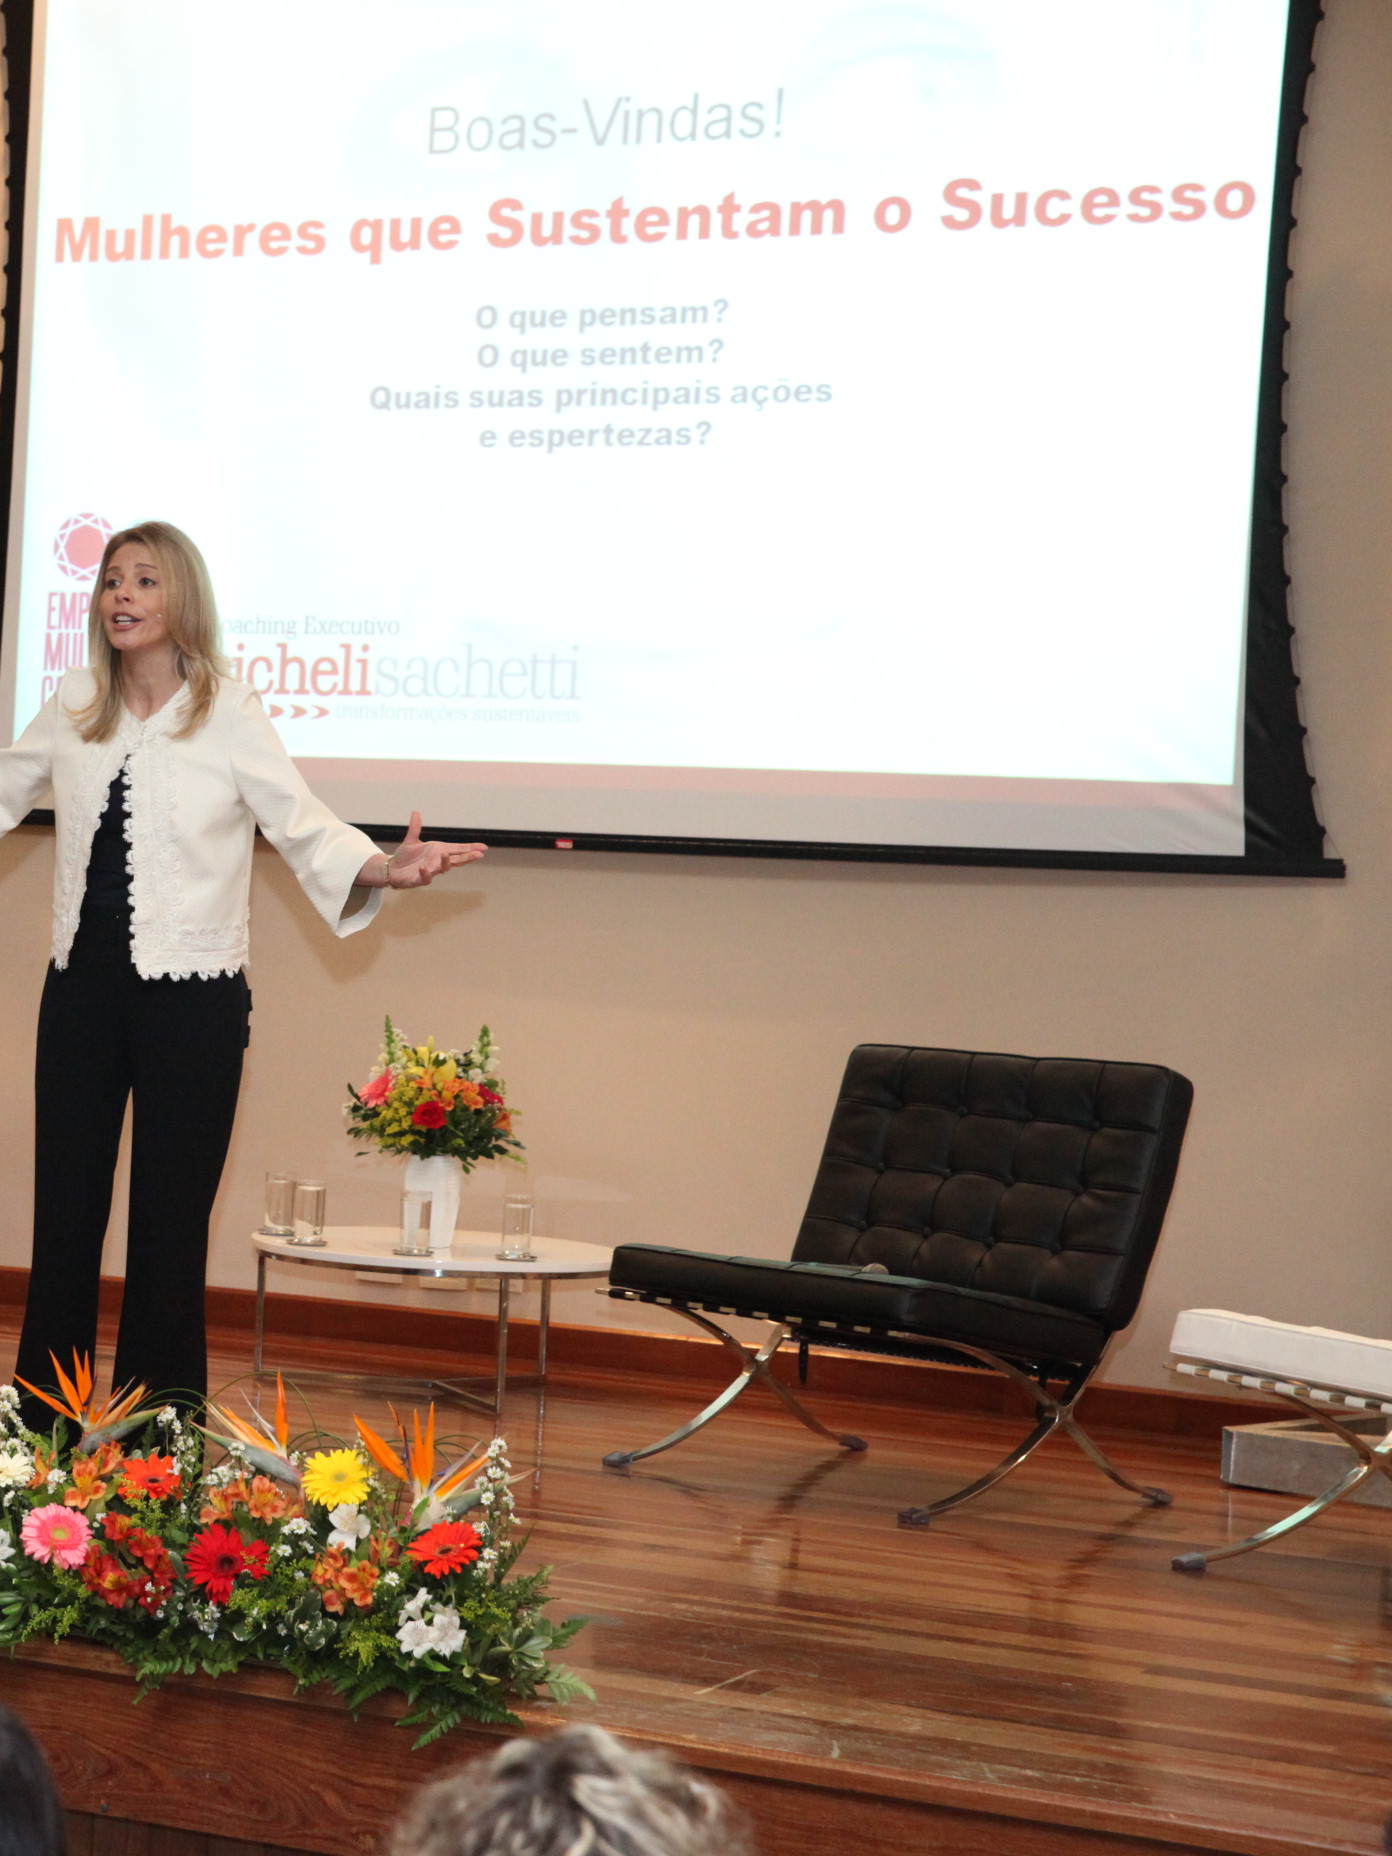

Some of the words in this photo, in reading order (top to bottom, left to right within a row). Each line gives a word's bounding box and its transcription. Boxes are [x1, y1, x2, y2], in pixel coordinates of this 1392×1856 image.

[428, 87, 784, 155] Boas-Vindas!
[54, 213, 327, 263] Mulheres
[349, 214, 462, 265] que
[486, 190, 846, 249] Sustentam
[873, 195, 912, 233] o
[940, 177, 1256, 231] Sucesso
[475, 306, 498, 330] O
[508, 308, 568, 335] que
[578, 298, 729, 333] pensam?
[476, 344, 499, 368] O
[510, 347, 569, 373] que
[580, 338, 724, 367] sentem?
[369, 385, 459, 411] Quais
[469, 387, 543, 409] suas
[555, 380, 721, 413] principais
[730, 378, 833, 411] ações
[479, 427, 498, 448] e
[508, 420, 711, 454] espertezas?
[222, 614, 297, 640] oaching
[305, 614, 400, 636] Executivo
[231, 642, 582, 700] ichelisachetti
[336, 702, 467, 724] transformações
[473, 705, 581, 724] sustentáveis
